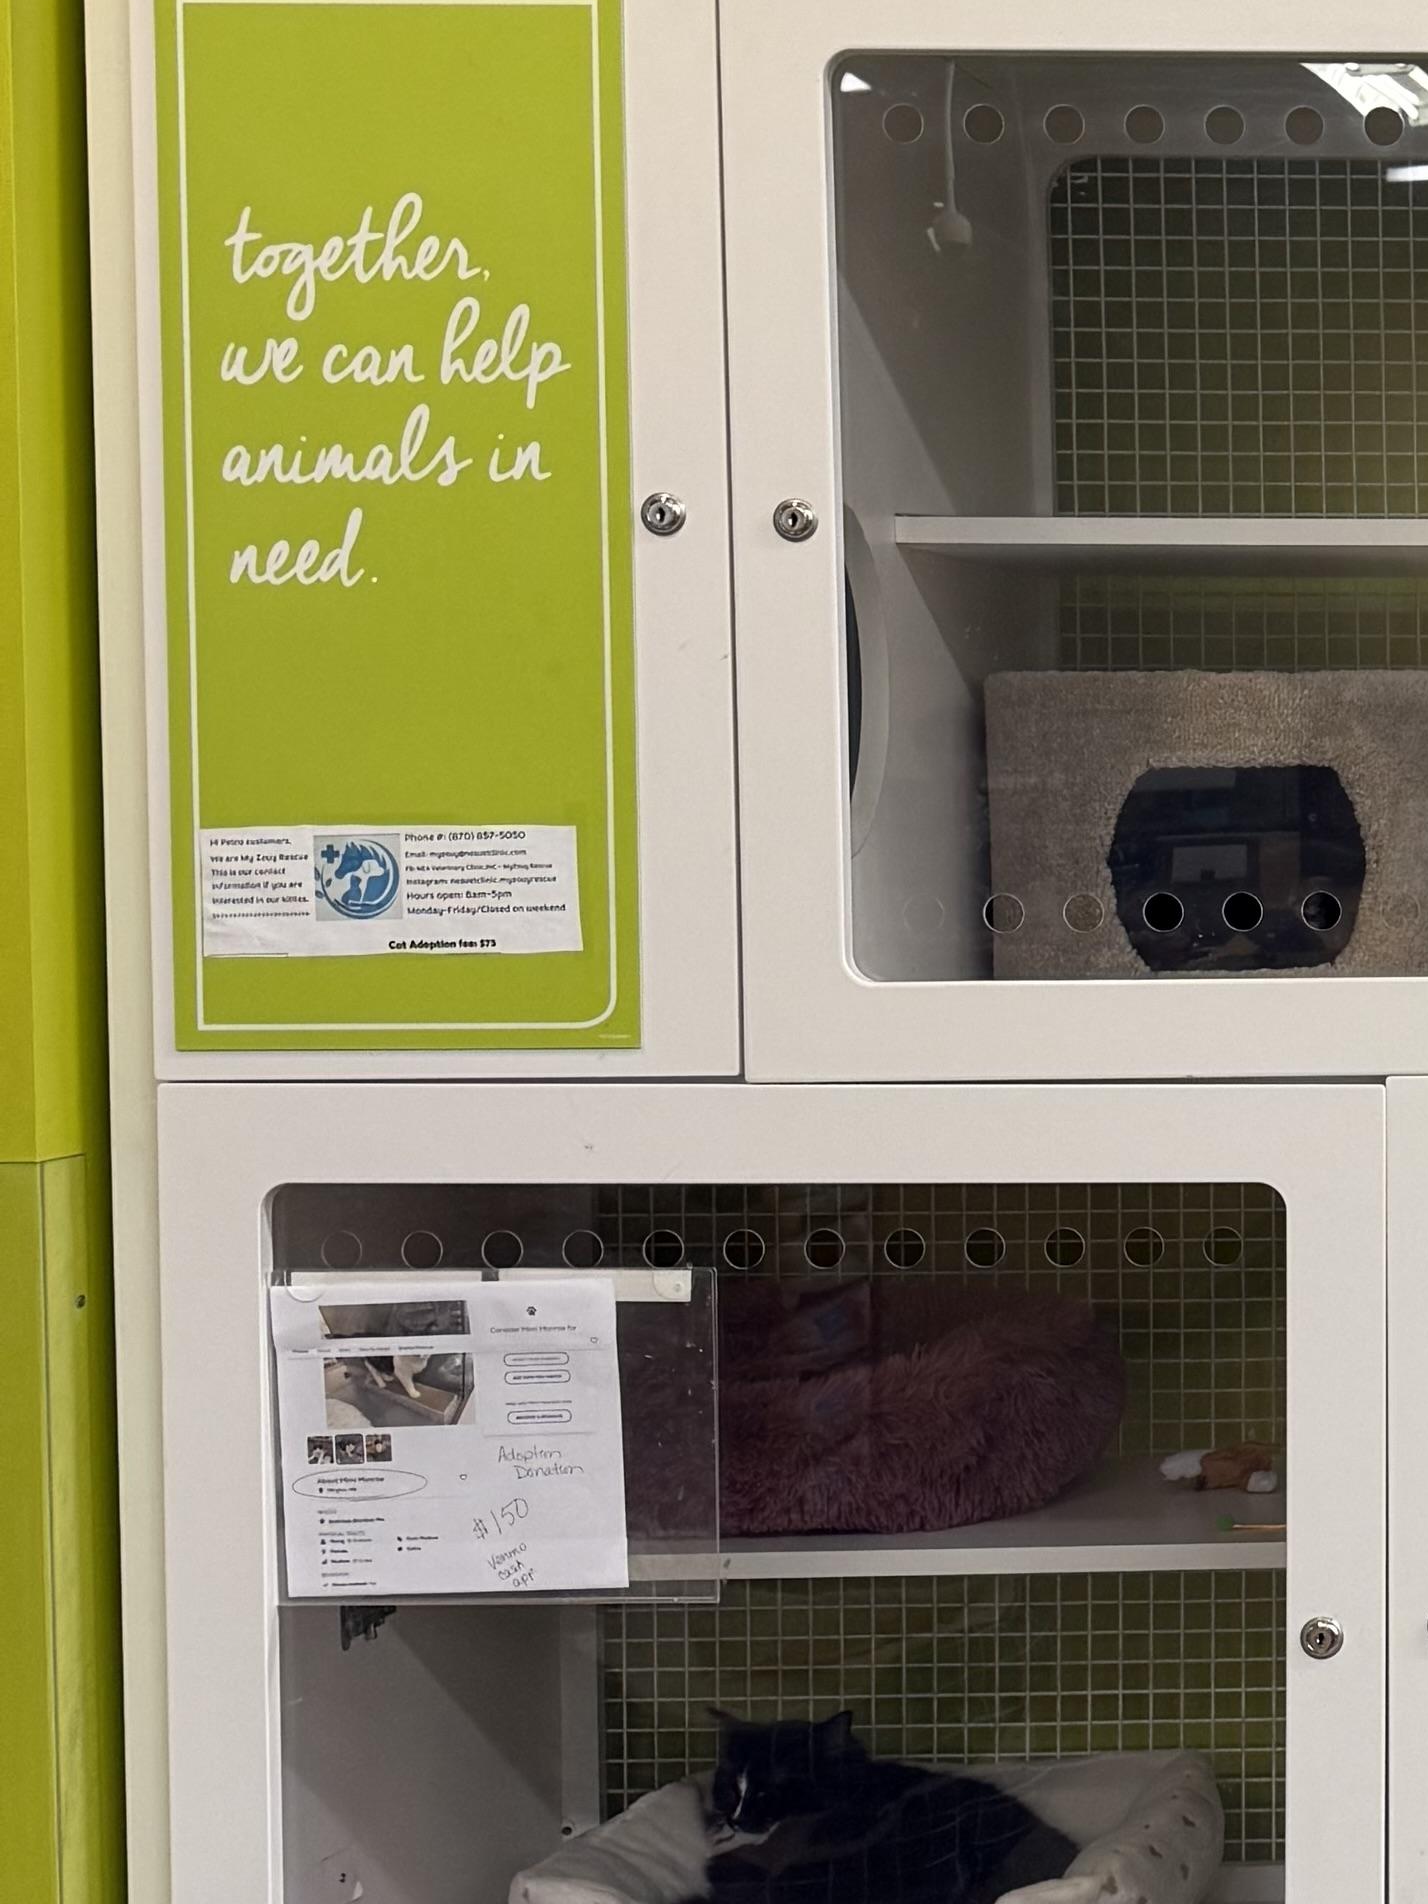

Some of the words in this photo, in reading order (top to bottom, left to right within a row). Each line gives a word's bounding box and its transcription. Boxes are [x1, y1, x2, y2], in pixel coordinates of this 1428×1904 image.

[220, 337, 304, 385] we
[322, 343, 425, 386] can
[440, 296, 572, 409] help
[222, 403, 474, 486] animals
[488, 433, 553, 482] in
[229, 506, 379, 588] need.
[404, 833, 435, 843] Phone
[406, 891, 435, 900] Hours
[512, 905, 525, 913] on
[526, 903, 567, 913] weekend
[388, 939, 407, 950] Cat
[409, 939, 457, 951] Adoption
